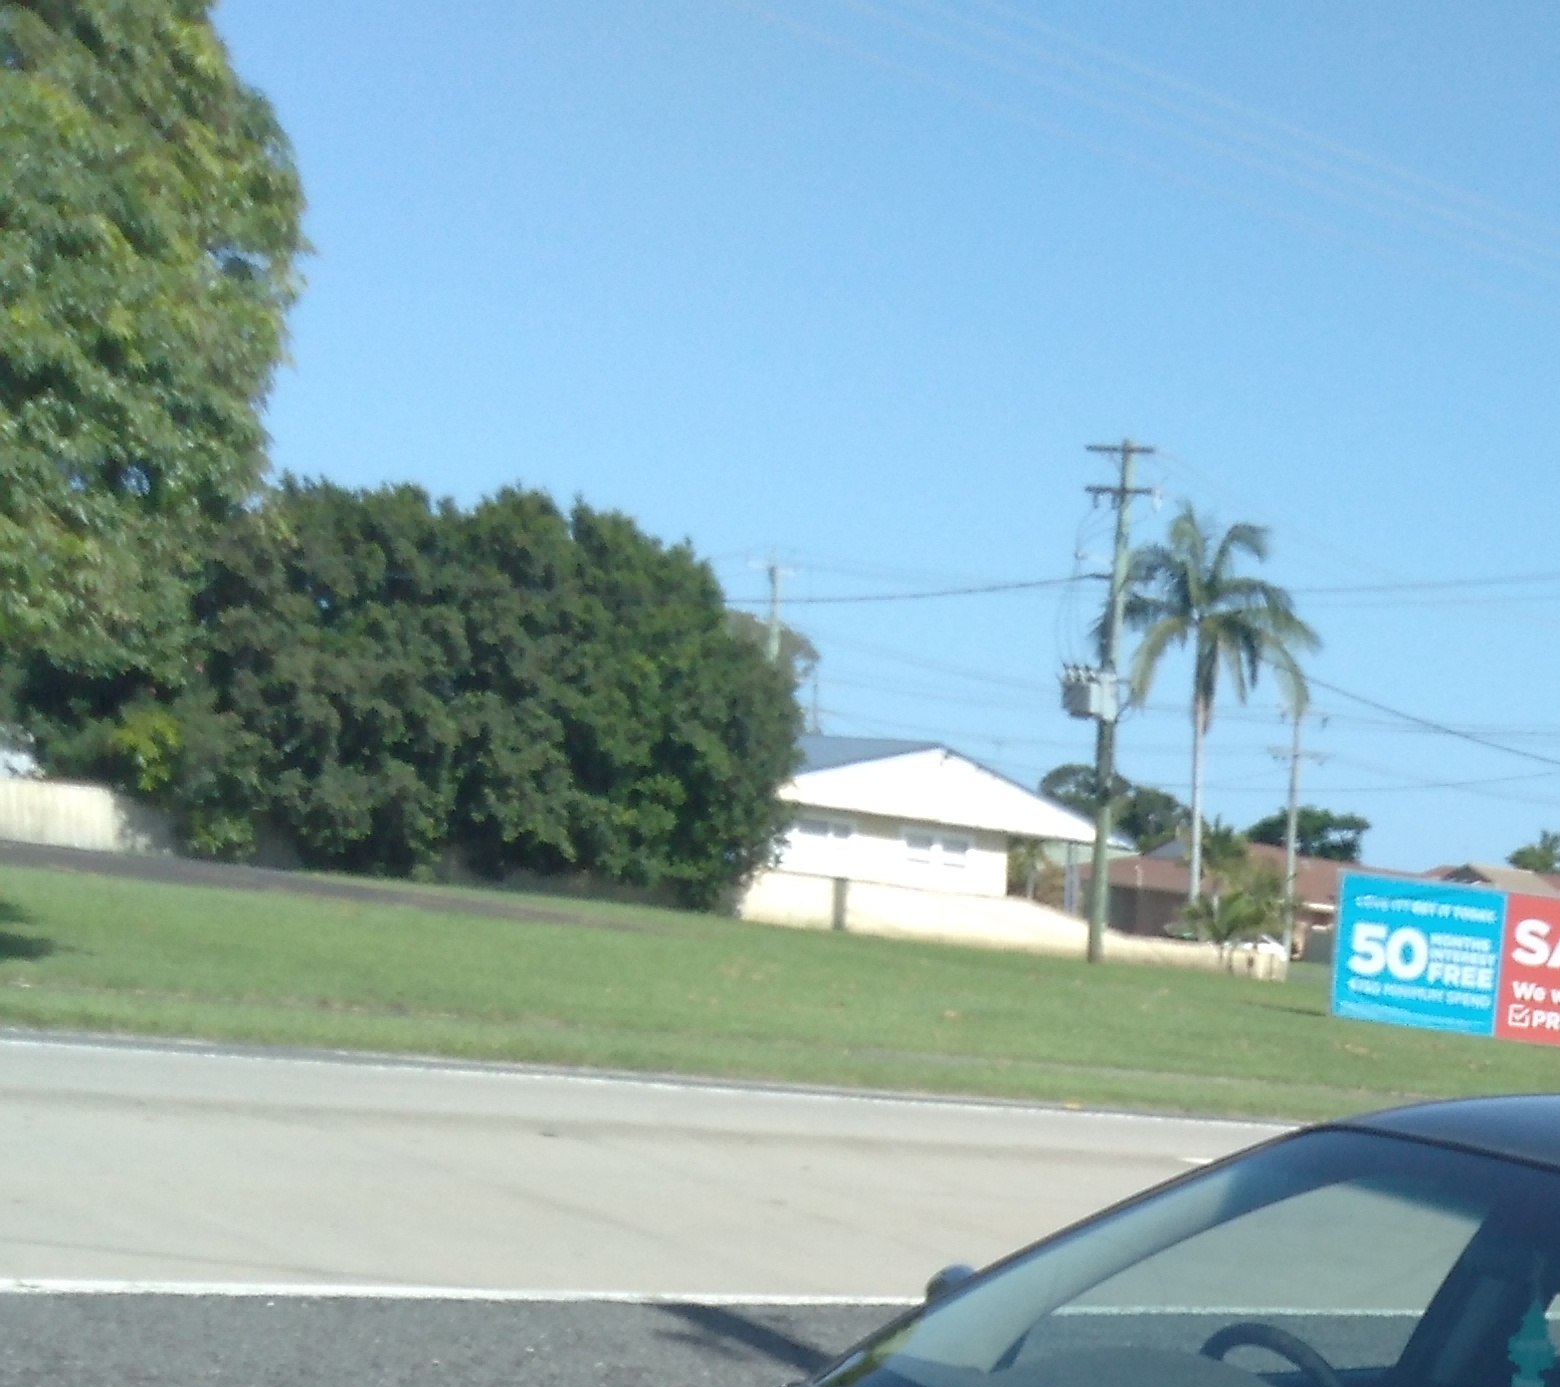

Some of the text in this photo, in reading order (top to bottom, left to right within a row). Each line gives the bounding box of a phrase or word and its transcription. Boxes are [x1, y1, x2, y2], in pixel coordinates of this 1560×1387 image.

[1347, 922, 1428, 980] 50
[1427, 961, 1494, 989] FREE
[1512, 981, 1545, 1001] We
